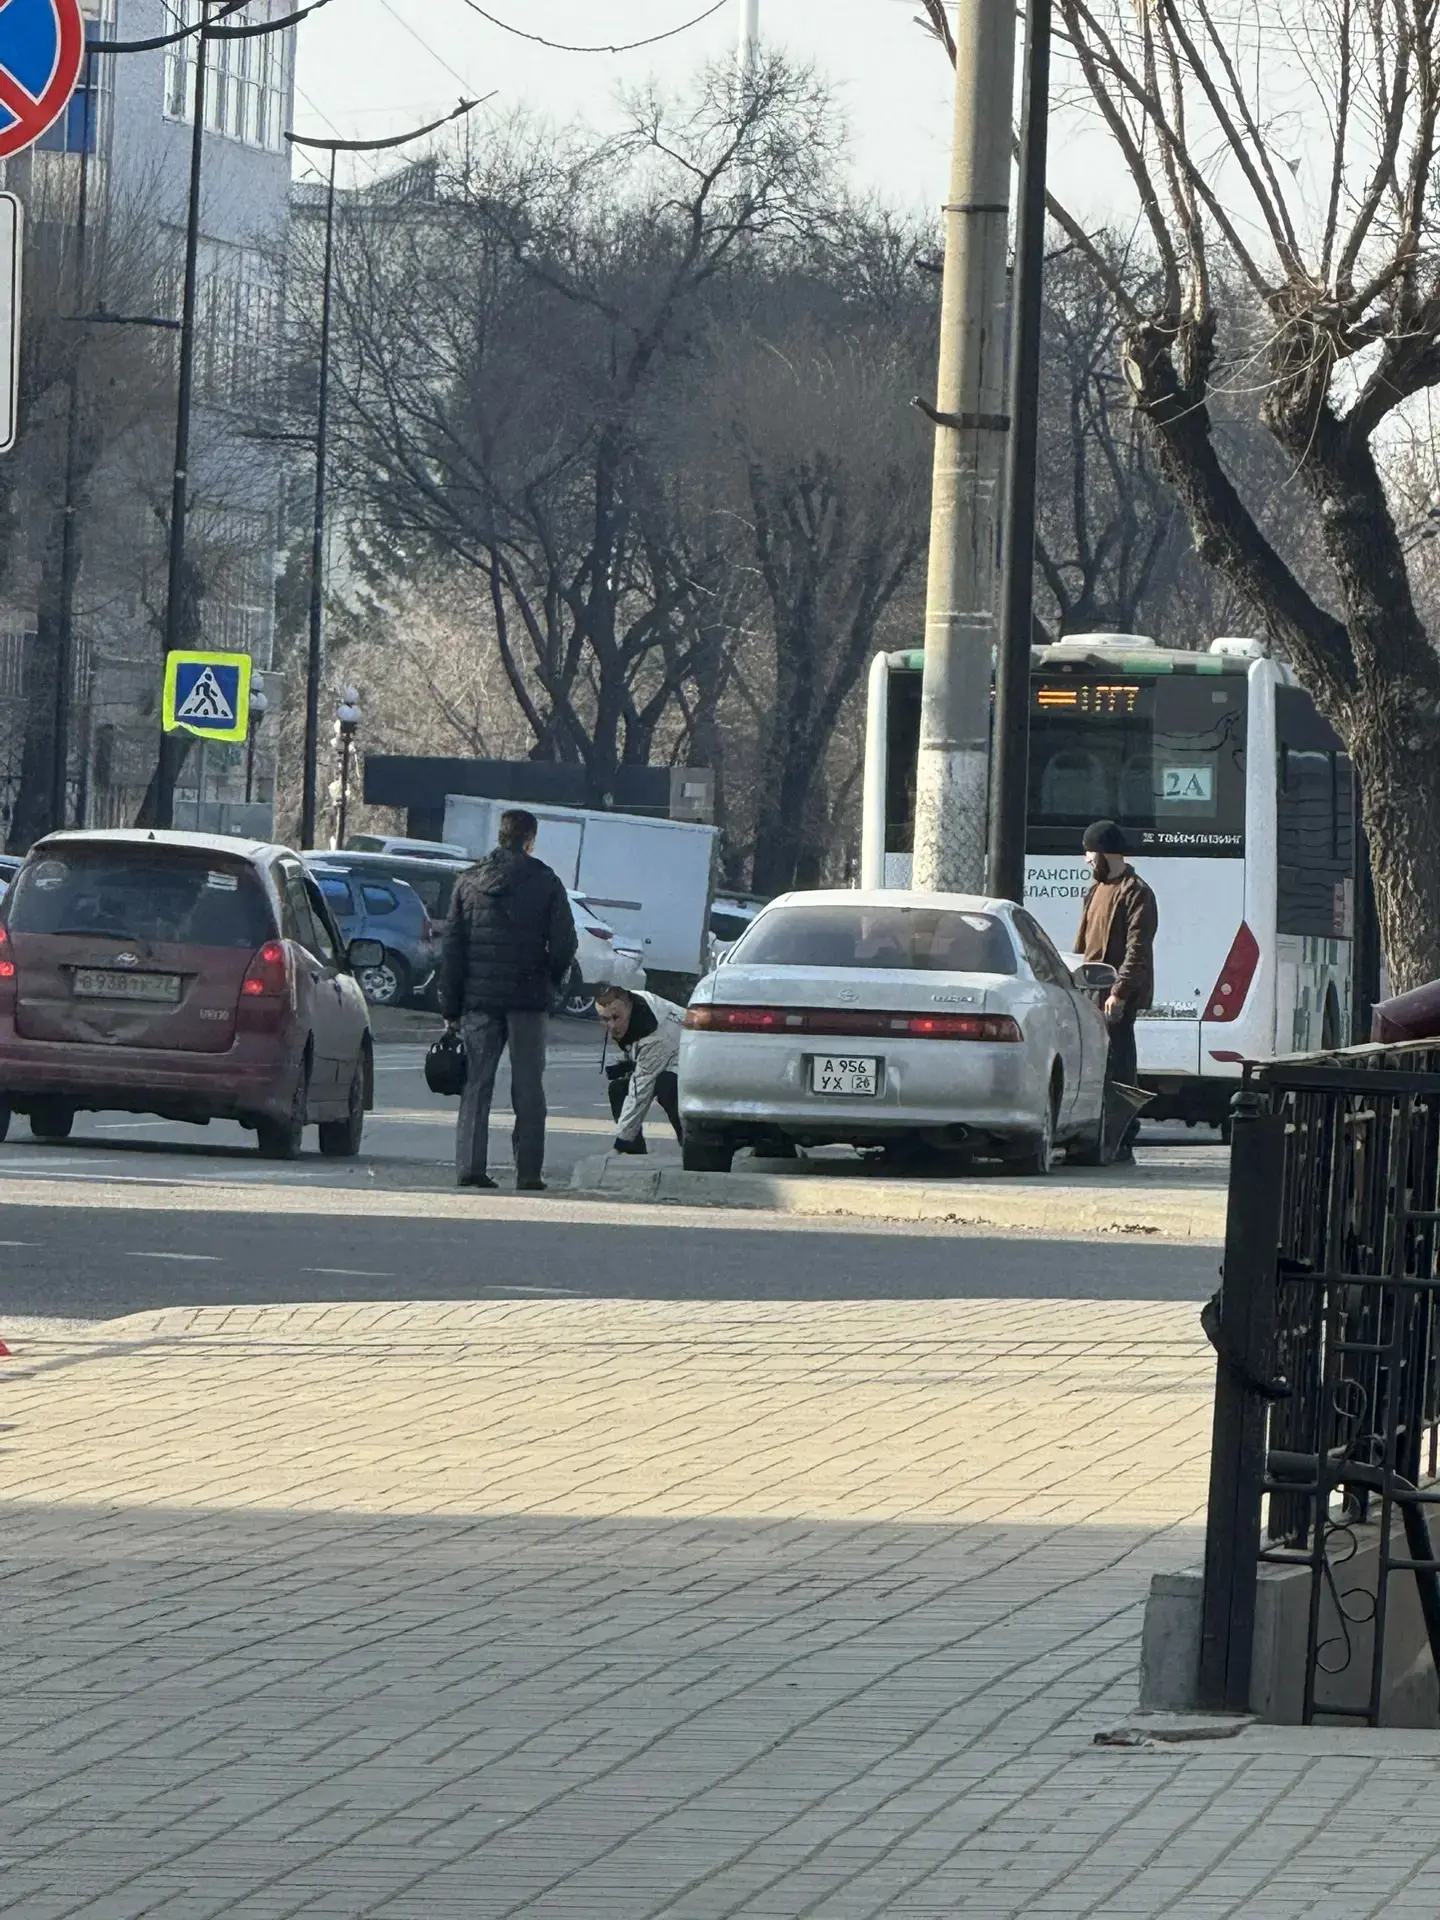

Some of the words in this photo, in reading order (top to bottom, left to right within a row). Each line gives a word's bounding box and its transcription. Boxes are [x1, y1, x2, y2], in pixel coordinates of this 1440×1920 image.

[1025, 868, 1092, 881] РАНСПО
[823, 1059, 834, 1073] А
[839, 1059, 867, 1074] 956
[821, 1076, 843, 1091] УХ
